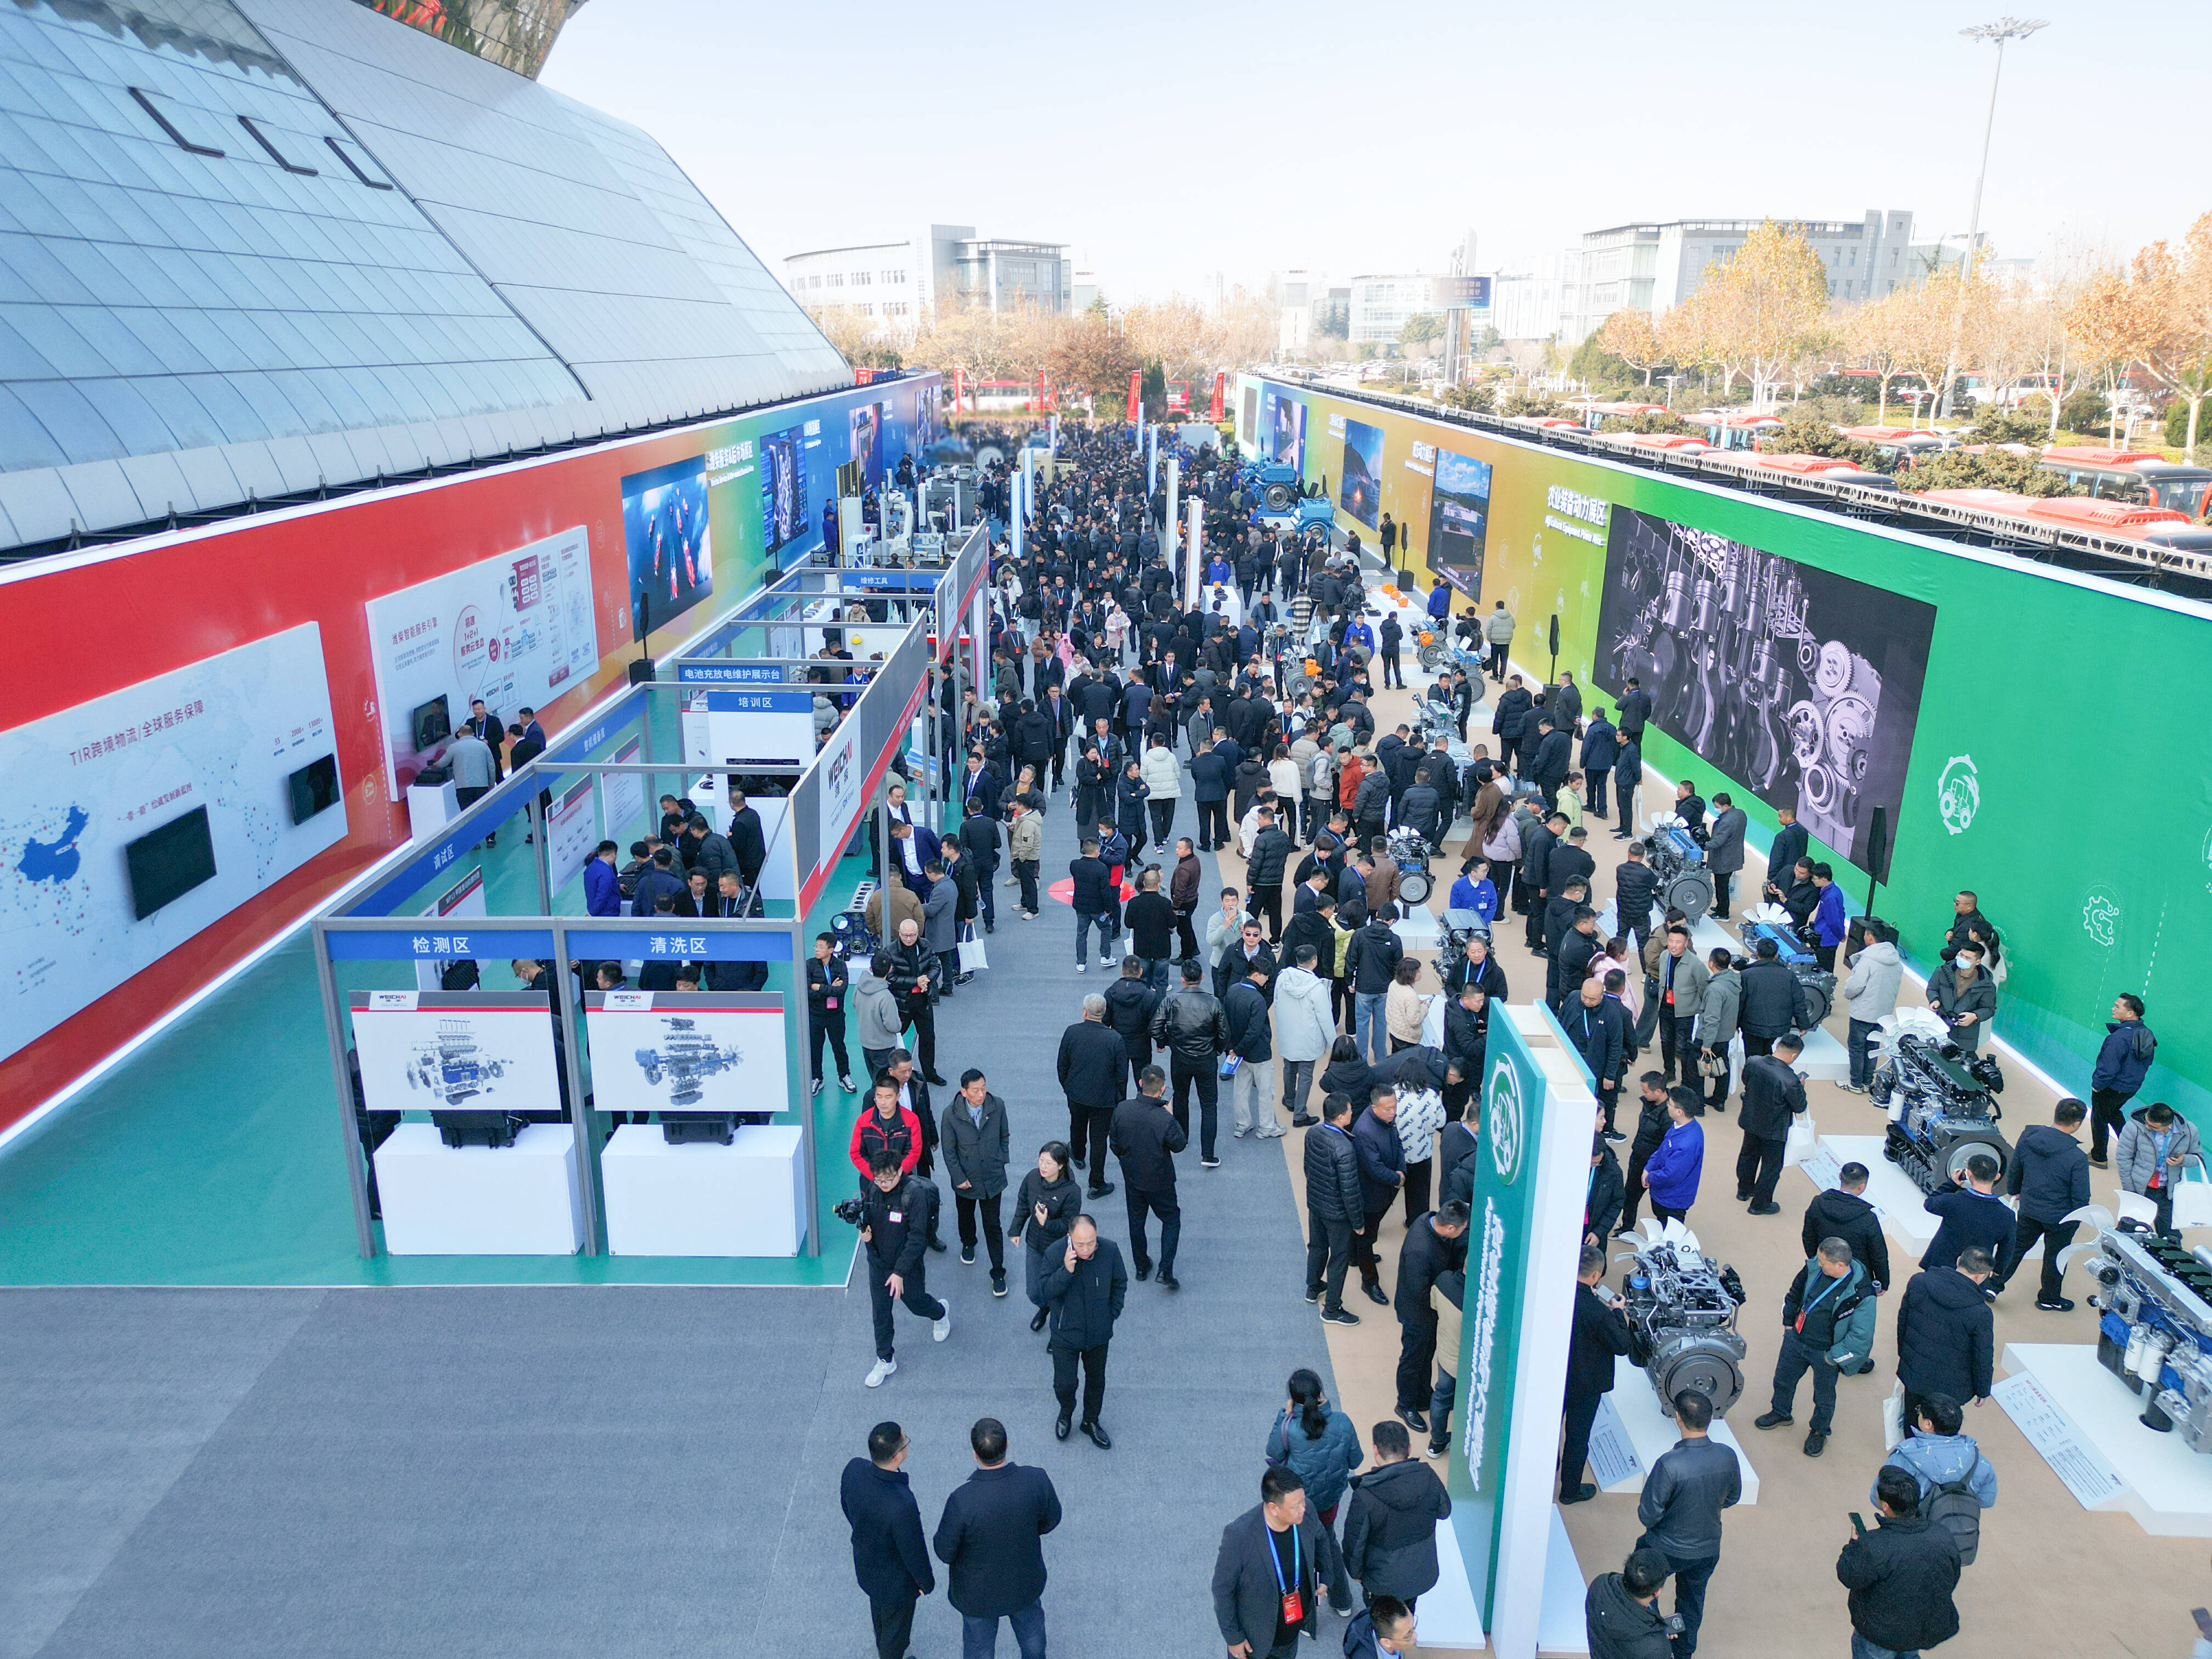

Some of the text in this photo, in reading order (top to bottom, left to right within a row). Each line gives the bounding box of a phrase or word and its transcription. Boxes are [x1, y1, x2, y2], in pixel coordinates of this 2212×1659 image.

[1548, 485, 1606, 527] 农业装备动力展区
[392, 617, 438, 646] 潍柴智能服务引擎
[464, 627, 478, 641] 1+2+1
[685, 668, 780, 680] 电池充放电维护展示台
[738, 697, 773, 708] 培训区
[70, 699, 205, 766] TIR跨境物流/全球服务保障
[828, 737, 852, 791] WEICHAI
[433, 843, 455, 870] 调试区
[413, 936, 471, 953] 检测区
[650, 936, 707, 954] 清洗区
[1399, 1102, 1413, 1118] SAMPLE
[1418, 1101, 1431, 1116] SAMPLE
